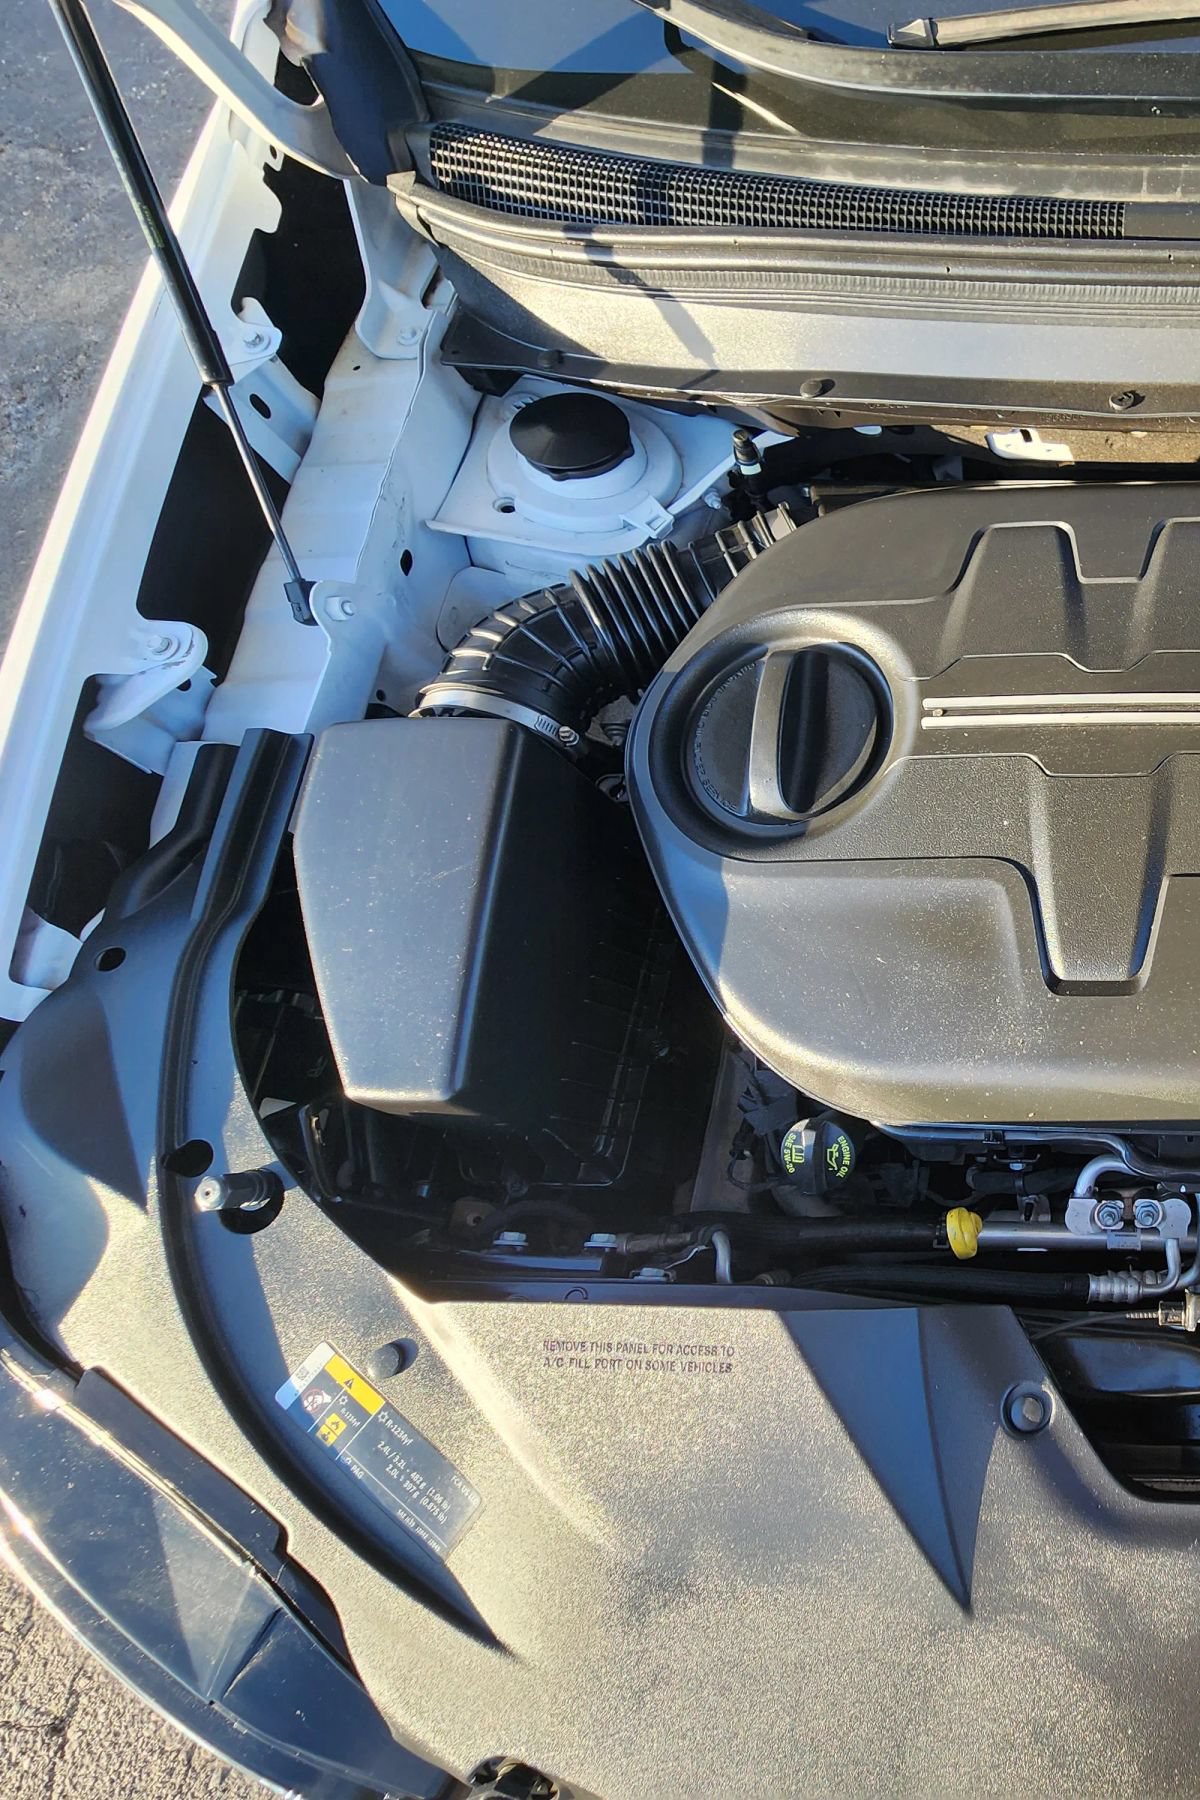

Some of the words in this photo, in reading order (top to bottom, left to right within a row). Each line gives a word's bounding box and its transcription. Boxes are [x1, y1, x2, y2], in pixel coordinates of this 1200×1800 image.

[785, 1132, 796, 1148] SAE
[837, 1135, 851, 1166] ENGINE
[784, 1149, 796, 1174] 5W-20
[836, 1167, 848, 1178] OIL
[543, 1340, 586, 1353] REMOVE
[590, 1341, 613, 1353] THIS
[616, 1342, 649, 1354] PANEL
[652, 1343, 673, 1355] FOR
[676, 1344, 717, 1357] ACCESS
[720, 1345, 735, 1357] TO
[543, 1357, 564, 1369] A/C
[568, 1358, 590, 1369] FILL
[594, 1359, 622, 1370] PORT
[626, 1360, 642, 1371] ON
[645, 1361, 676, 1372] SOME
[680, 1361, 733, 1374] VEHICLES
[384, 1419, 414, 1447] R-1234yf
[351, 1465, 365, 1478] PAG
[403, 1481, 416, 1493] 397
[451, 1476, 463, 1488] FCA
